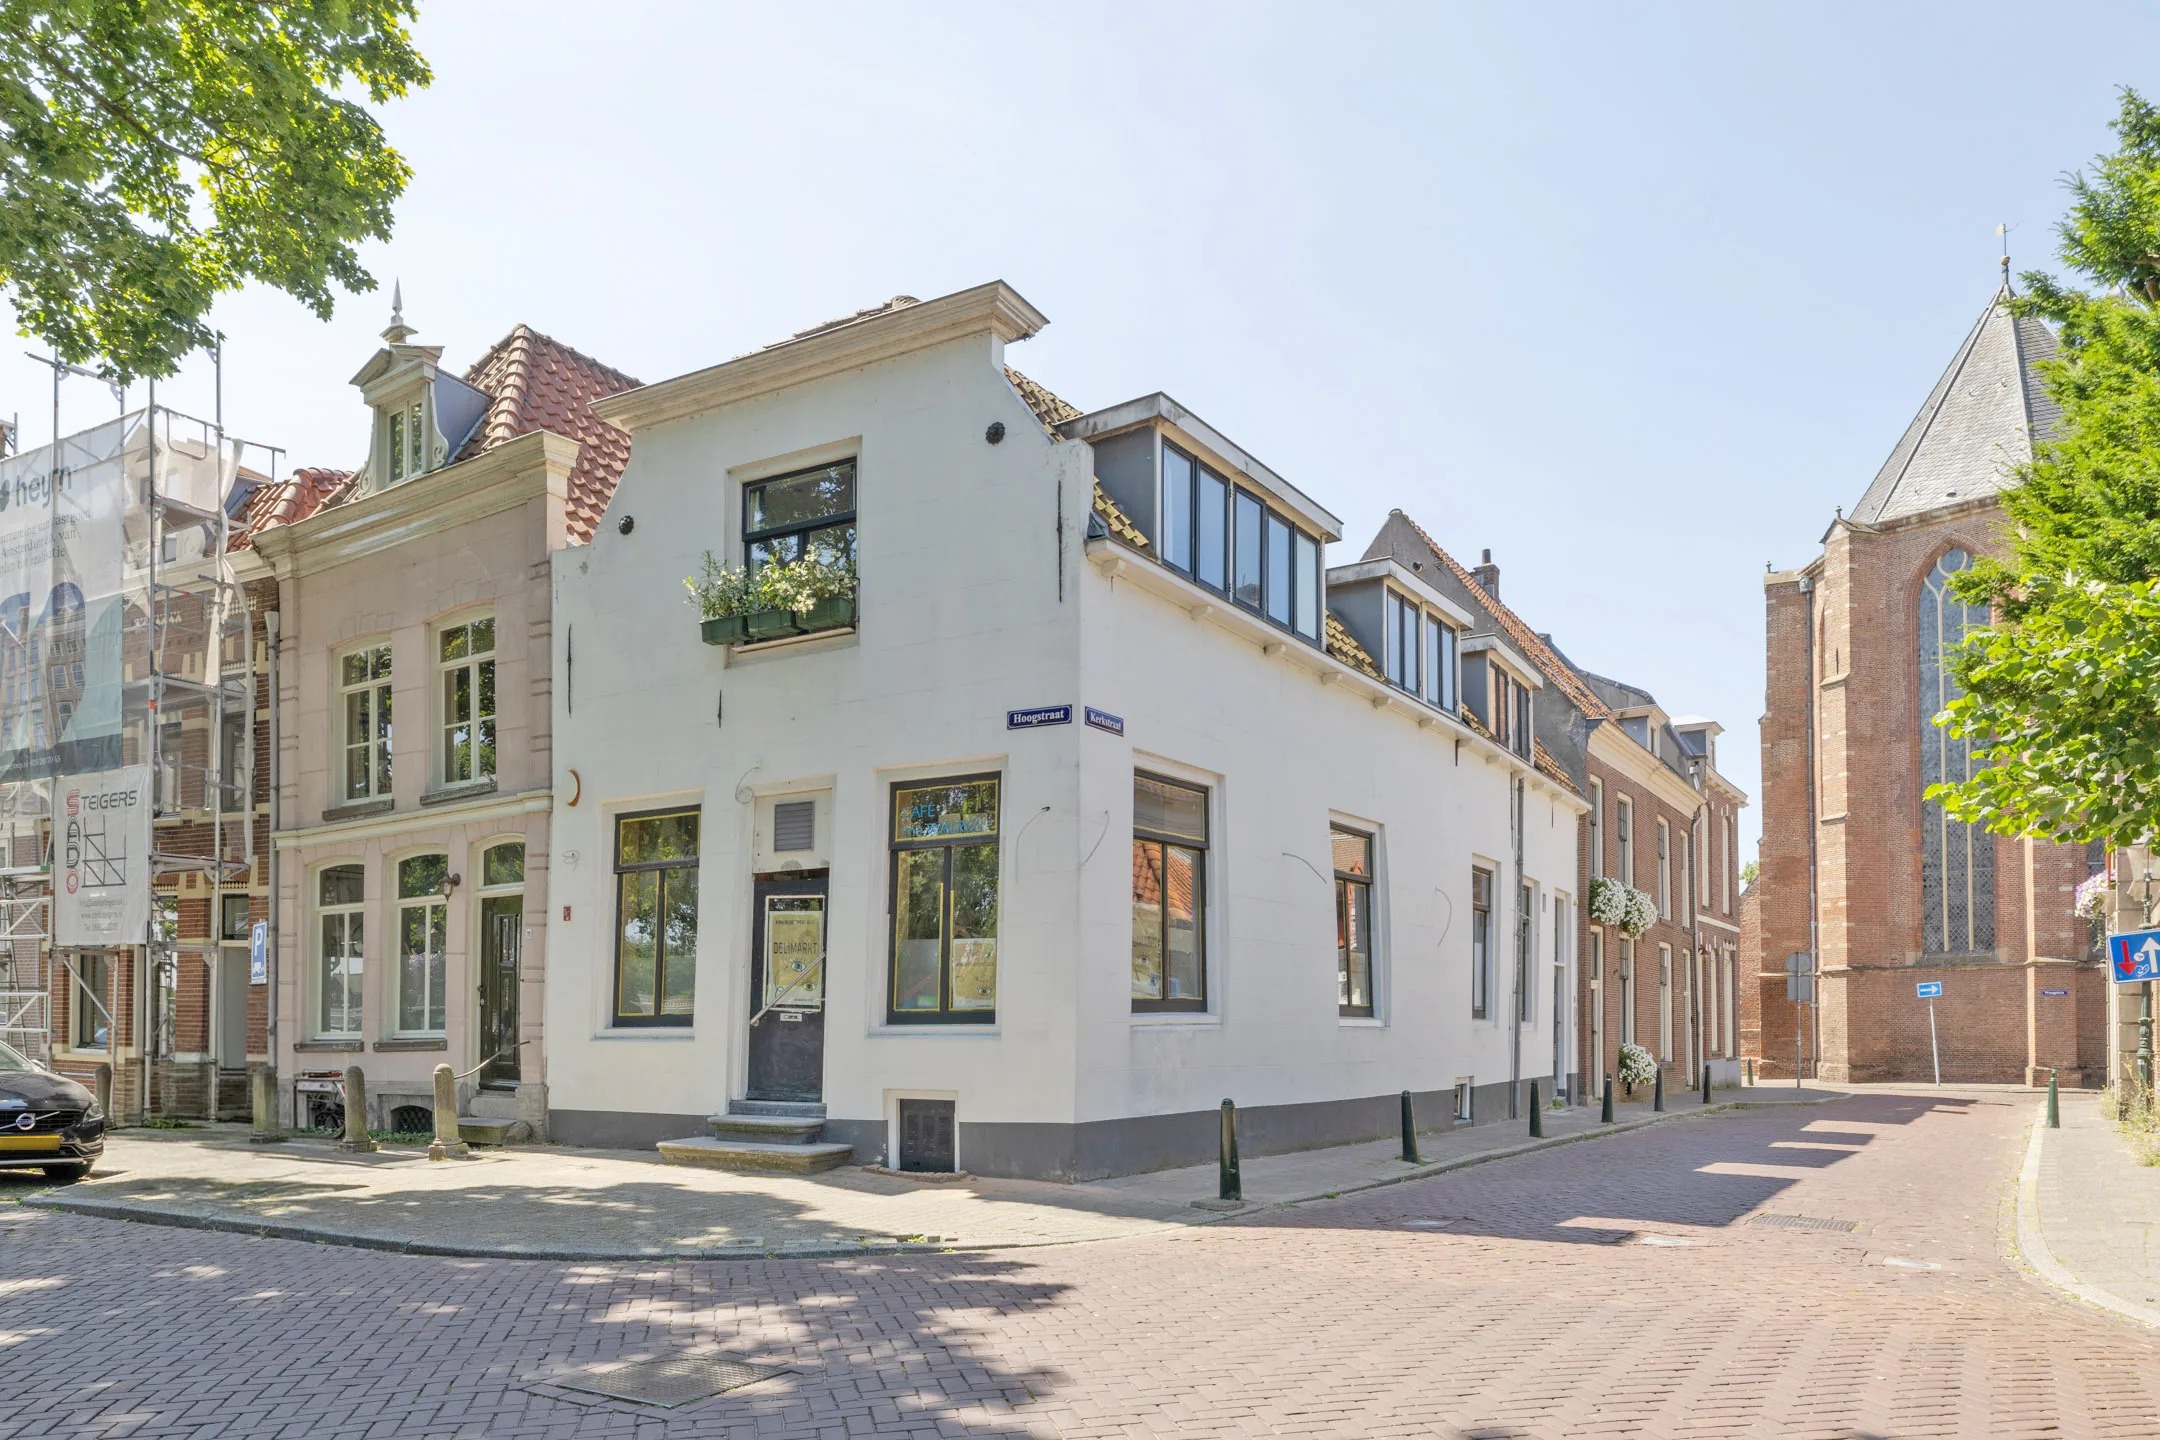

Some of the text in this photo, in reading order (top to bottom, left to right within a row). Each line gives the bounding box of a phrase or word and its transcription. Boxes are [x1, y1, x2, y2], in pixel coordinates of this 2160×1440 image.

[58, 529, 77, 541] van
[1013, 709, 1065, 725] Hoogstraat
[1090, 711, 1121, 732] Kerkstraat
[925, 816, 985, 837] WALRUS
[254, 928, 263, 957] P
[773, 942, 818, 955] DELIMARKT
